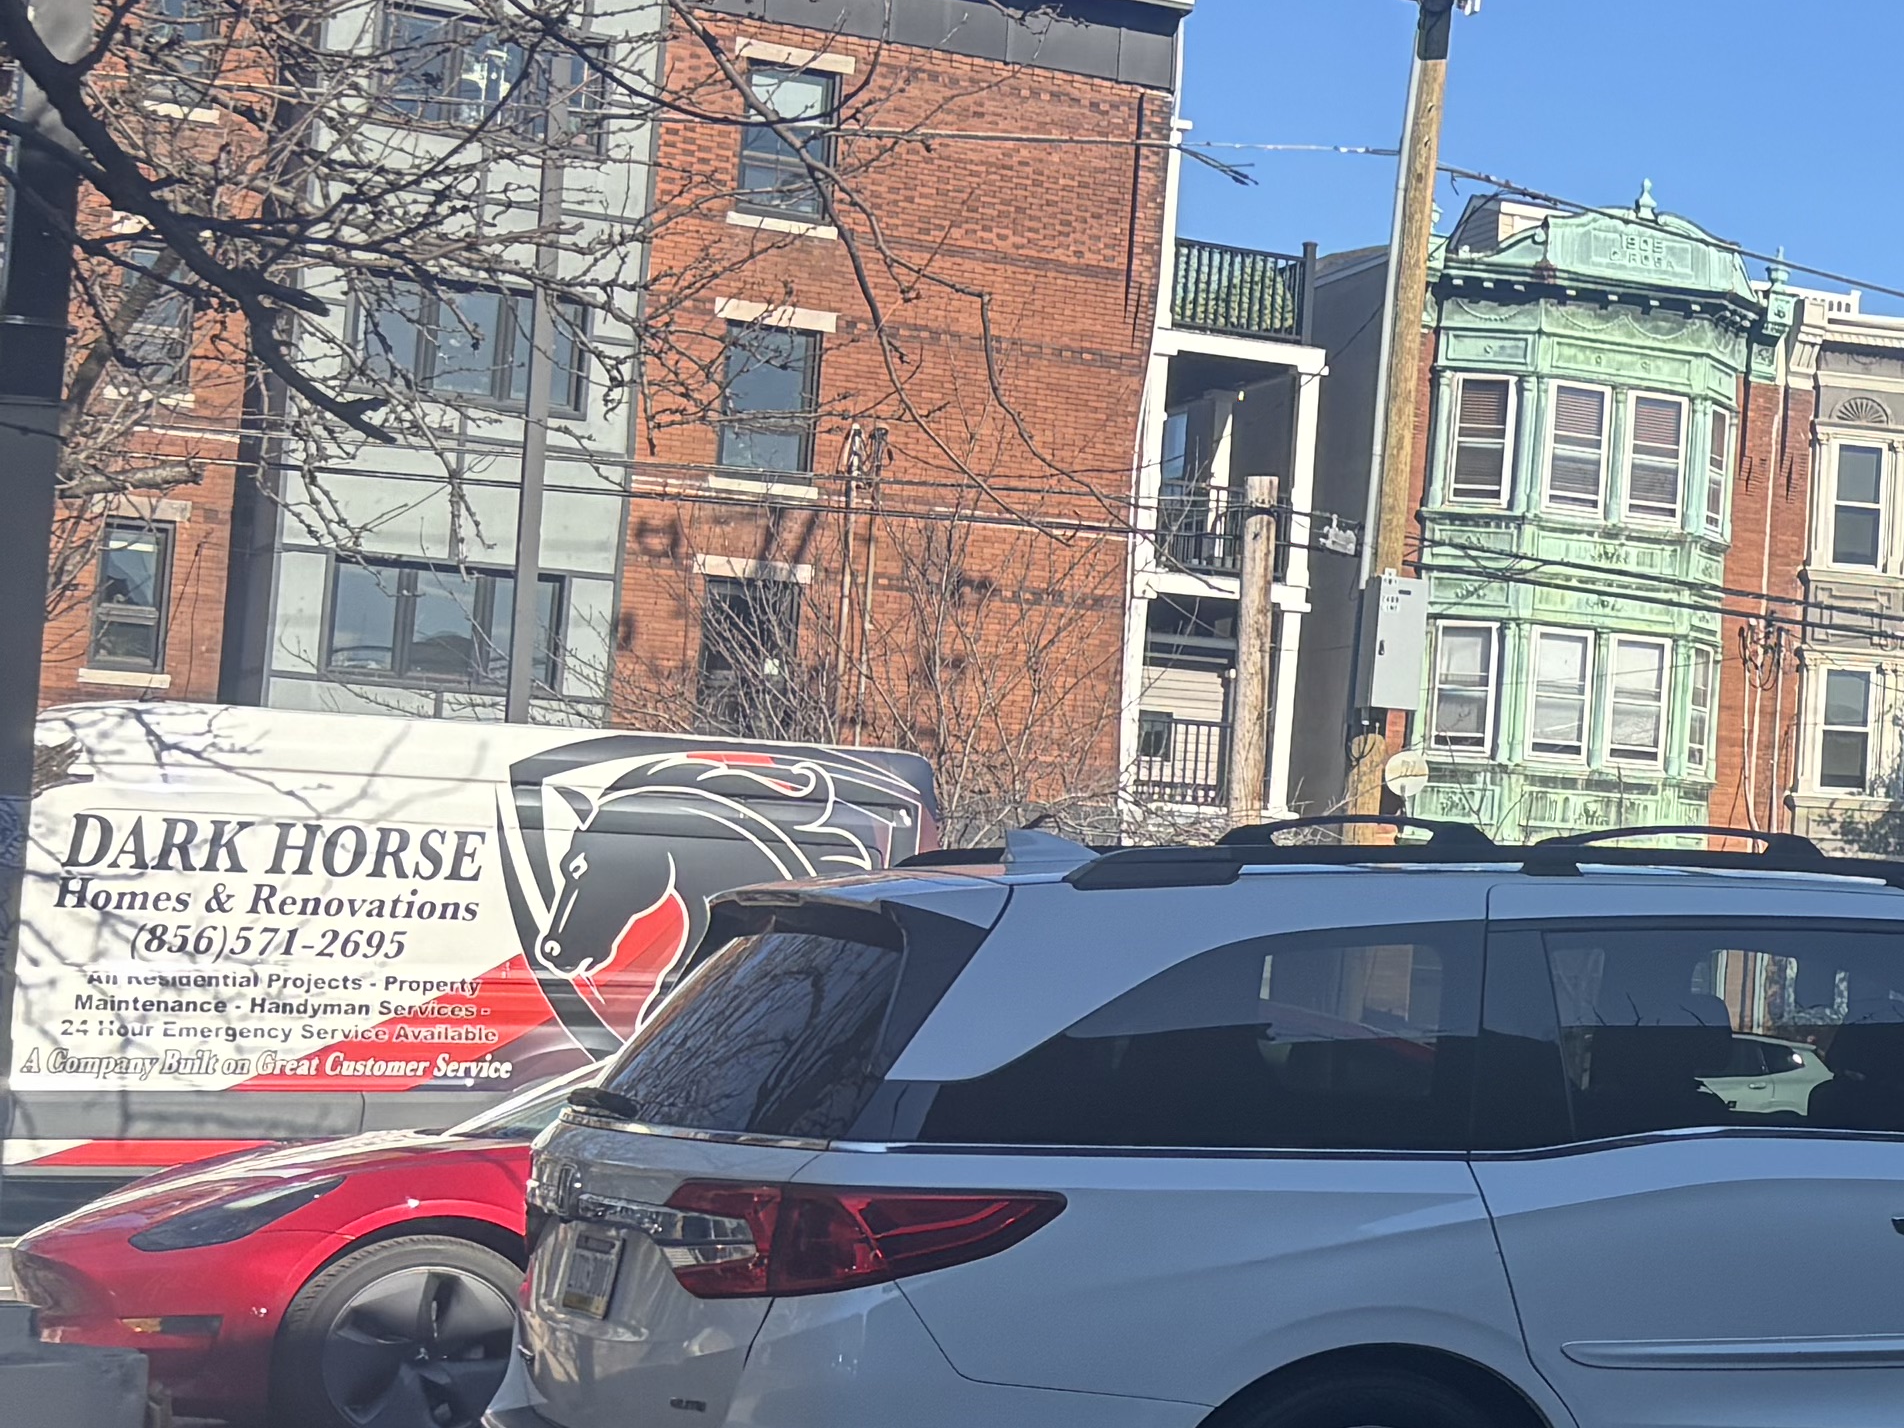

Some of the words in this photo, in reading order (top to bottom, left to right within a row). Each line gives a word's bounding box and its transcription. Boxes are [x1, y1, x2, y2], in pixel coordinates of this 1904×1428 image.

[61, 813, 256, 873] DARK
[264, 821, 487, 882] HORSE
[53, 876, 192, 913] Homes
[204, 882, 235, 914] &
[245, 883, 480, 922] Renovations
[130, 922, 408, 964] (856)571-2695
[86, 972, 118, 986] All
[266, 973, 363, 994] Projects
[383, 976, 482, 998] Property
[74, 994, 228, 1014] Maintenance
[250, 997, 371, 1019] Handyman
[378, 1000, 477, 1018] Services
[60, 1019, 90, 1037] 24
[98, 1020, 154, 1038] Hour
[162, 1021, 293, 1043] Emergency
[300, 1024, 389, 1042] Service
[392, 1025, 499, 1044] Available
[20, 1047, 41, 1074] A
[46, 1047, 160, 1082] Company
[159, 1049, 220, 1076] Built
[221, 1057, 251, 1075] on
[255, 1049, 320, 1076] Great
[325, 1051, 431, 1078] Customer
[432, 1053, 514, 1079] Service
